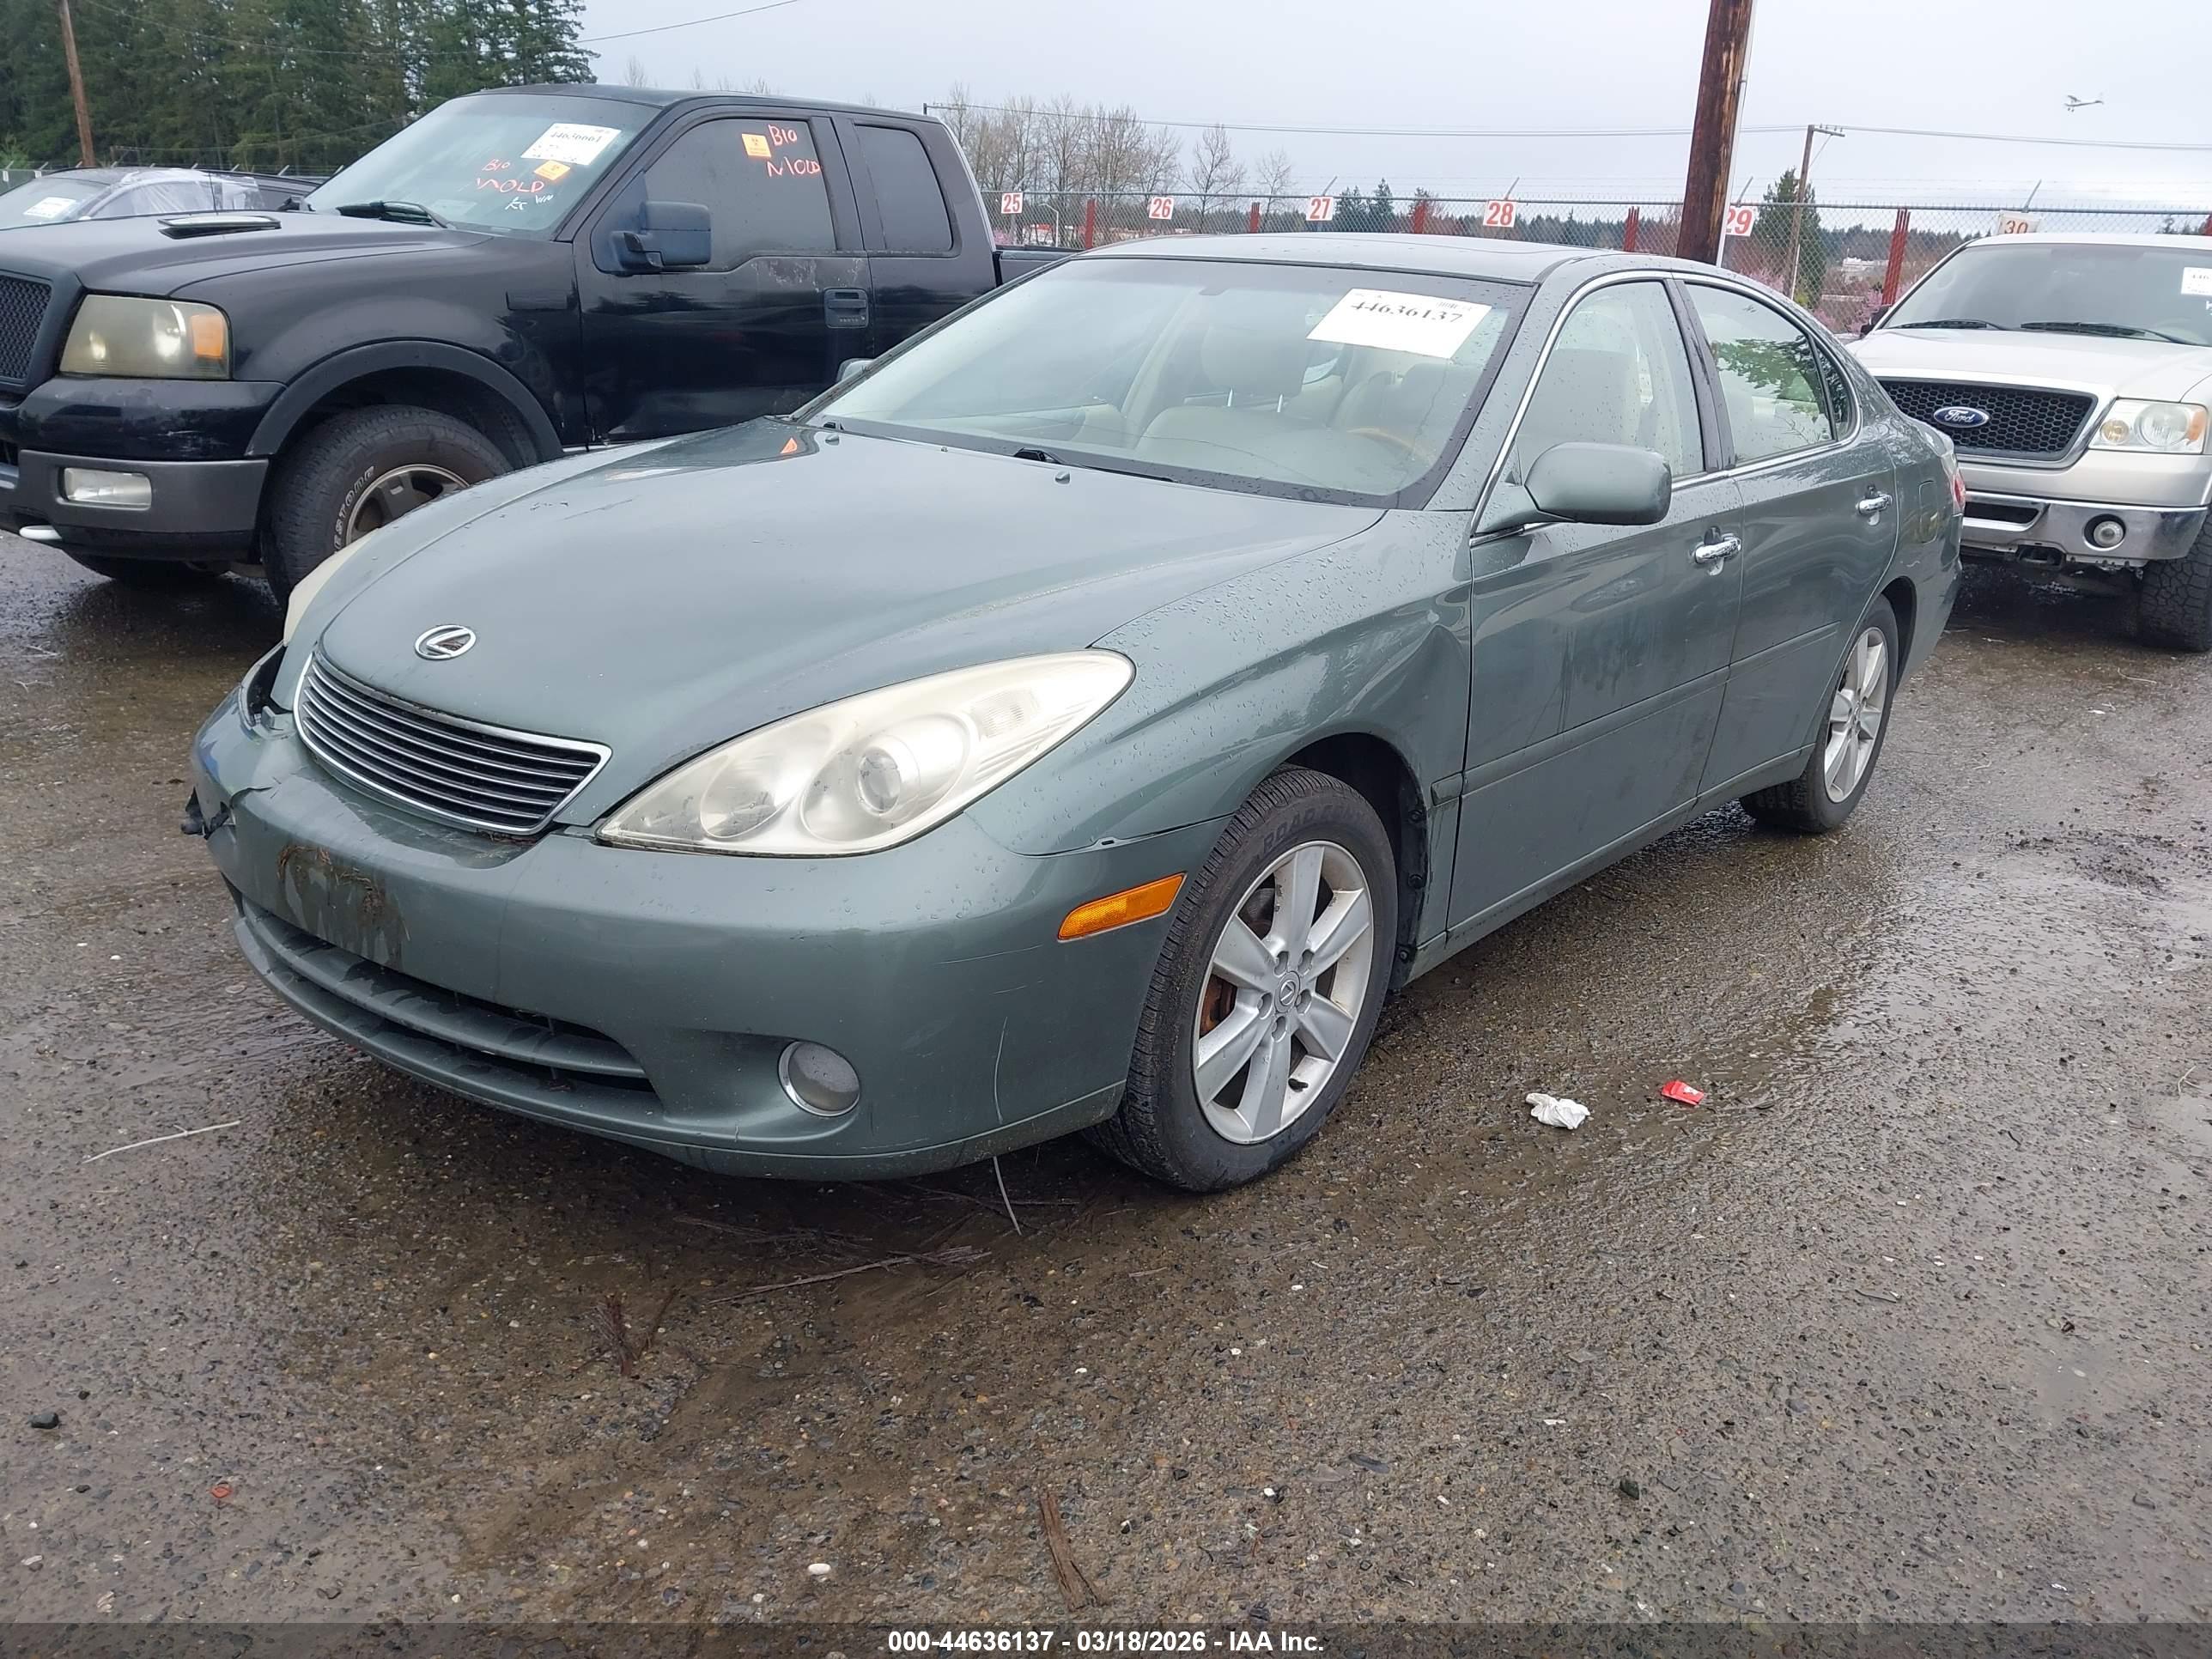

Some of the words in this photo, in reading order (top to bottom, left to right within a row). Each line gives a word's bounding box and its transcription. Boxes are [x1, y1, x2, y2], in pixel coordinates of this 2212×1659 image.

[1003, 194, 1021, 212] 25
[1152, 198, 1172, 218] 26
[1310, 198, 1331, 219] 27
[1486, 202, 1514, 226] 28
[2004, 220, 2028, 234] 30
[1351, 301, 1463, 323] 44636137
[1944, 410, 1976, 422] Ford
